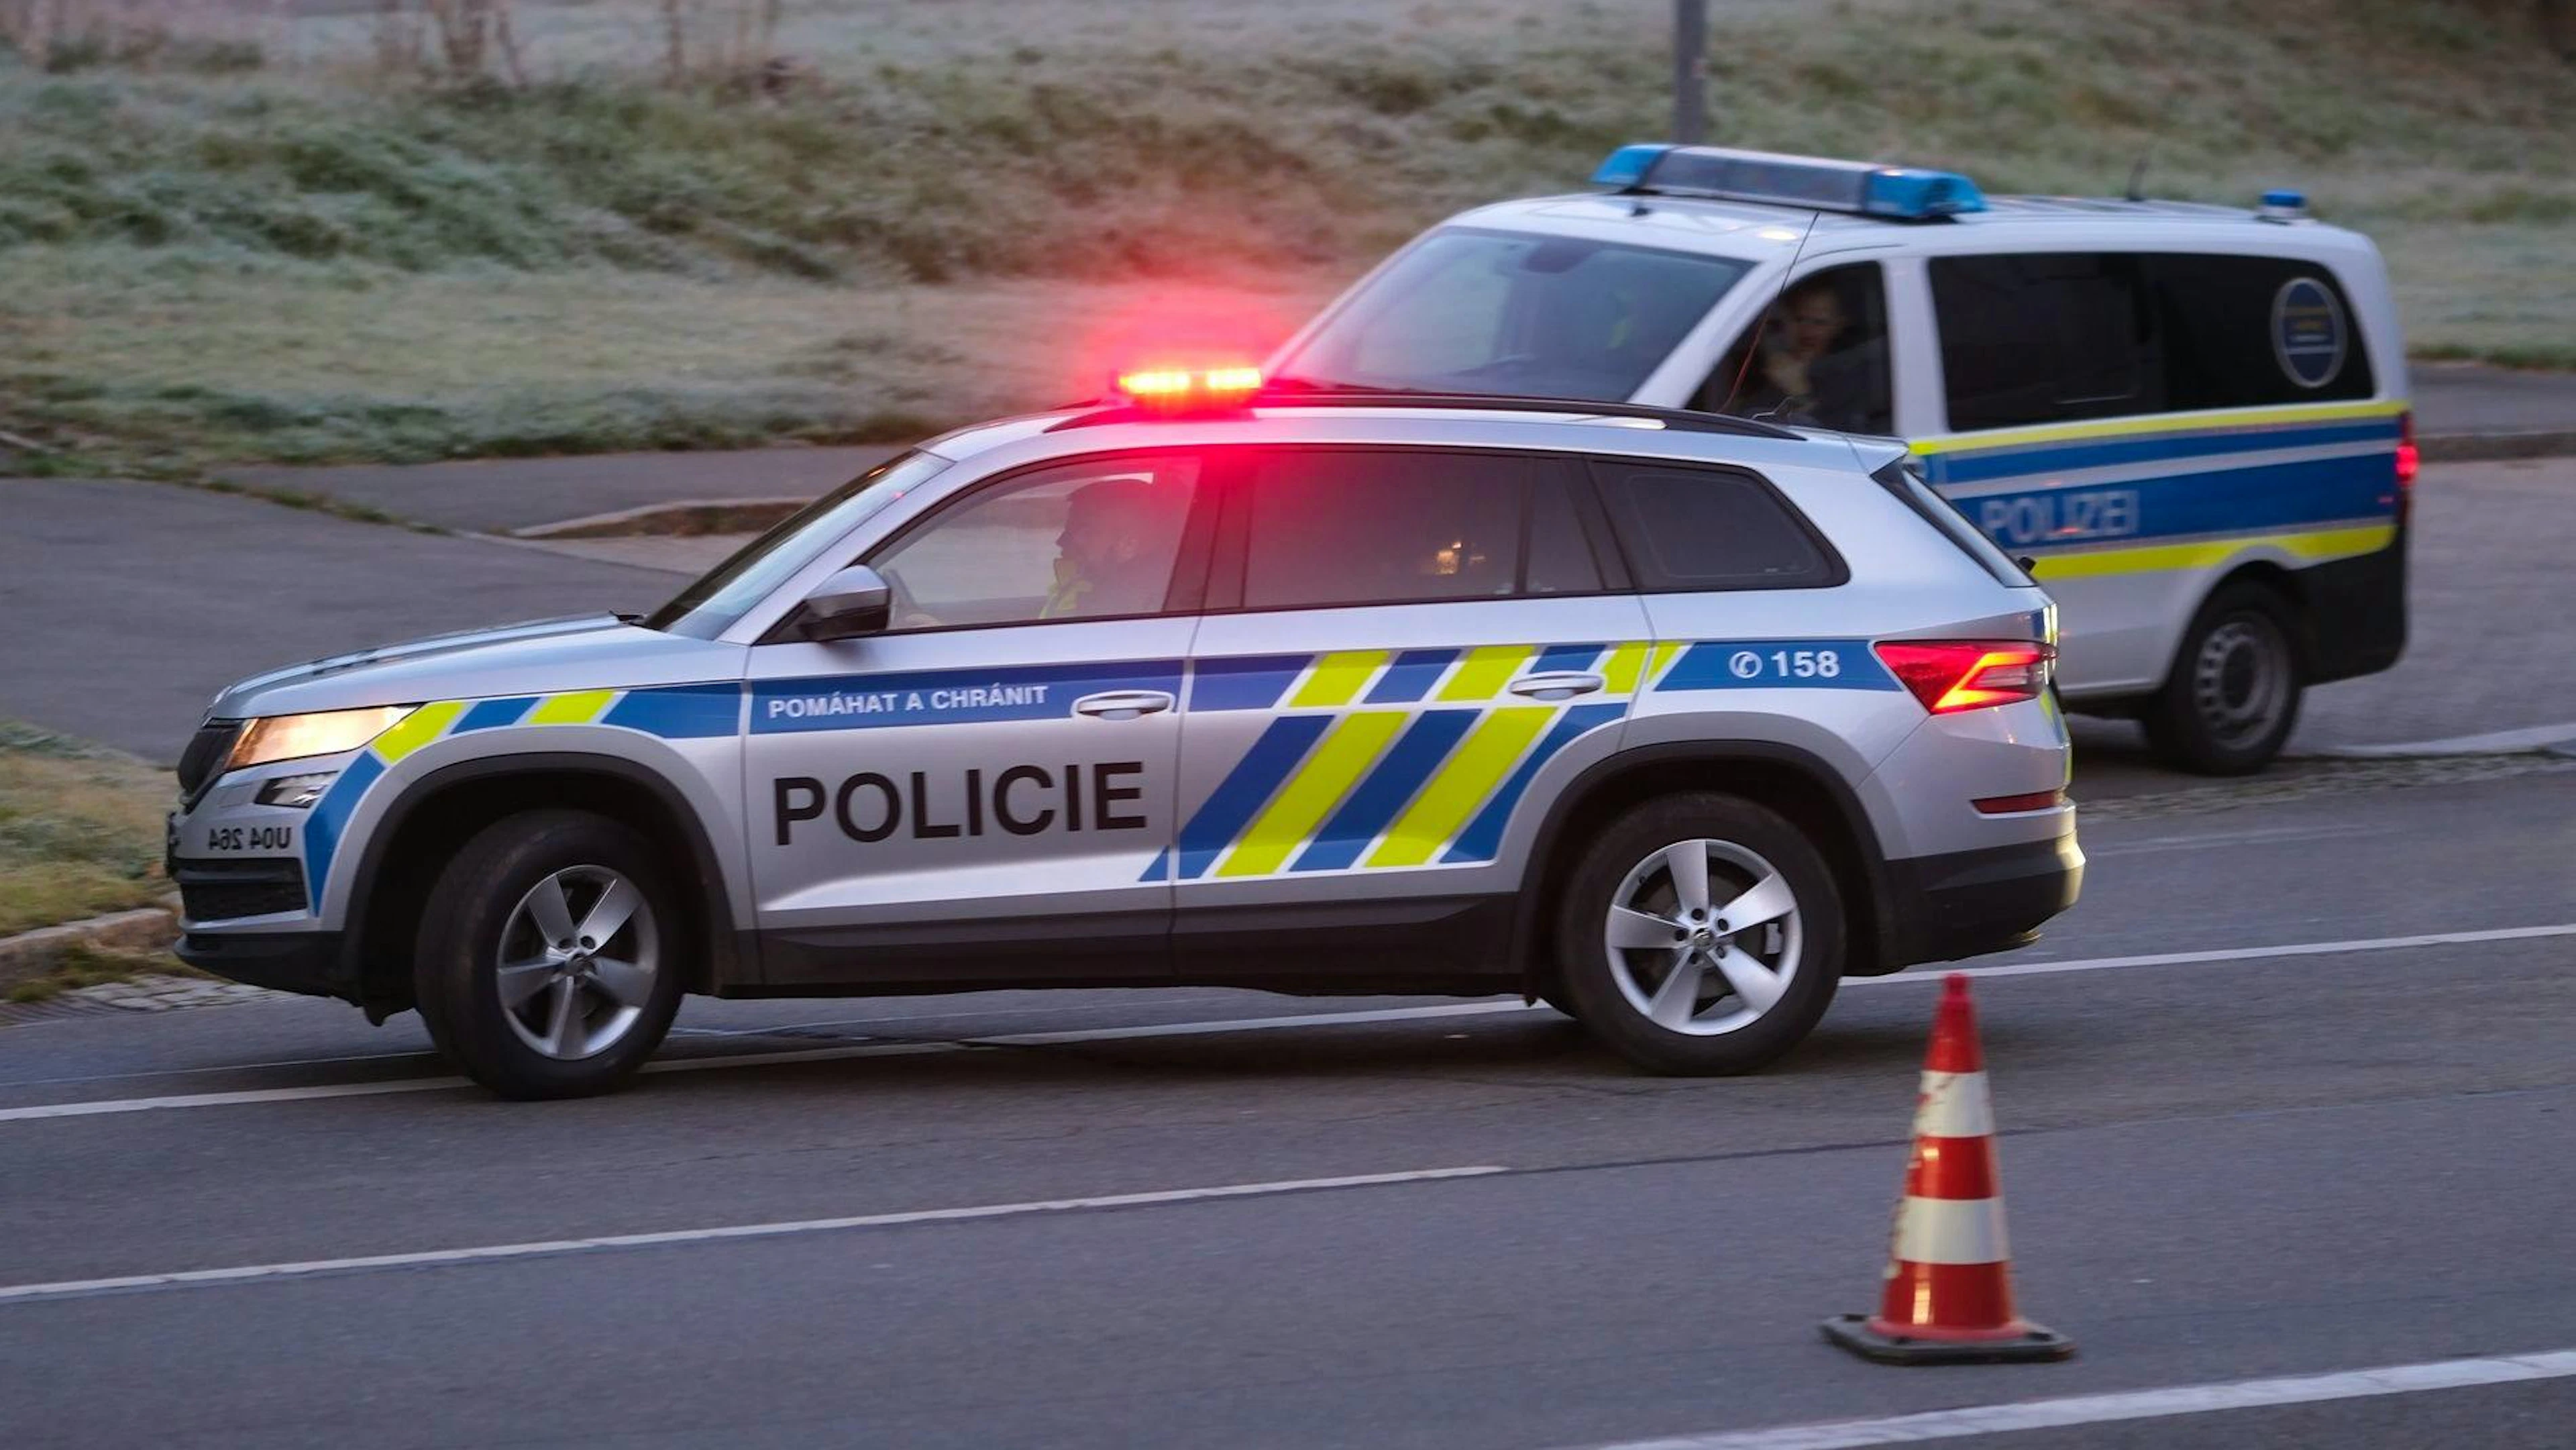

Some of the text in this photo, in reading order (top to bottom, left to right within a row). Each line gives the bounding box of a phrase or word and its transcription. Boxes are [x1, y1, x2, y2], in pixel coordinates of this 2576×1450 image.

[1981, 490, 2141, 542] POLIZEI
[1770, 650, 1840, 678] 158
[768, 682, 1049, 719] POMÁHAT A CHRÁNIT
[773, 761, 1147, 845] POLICIE
